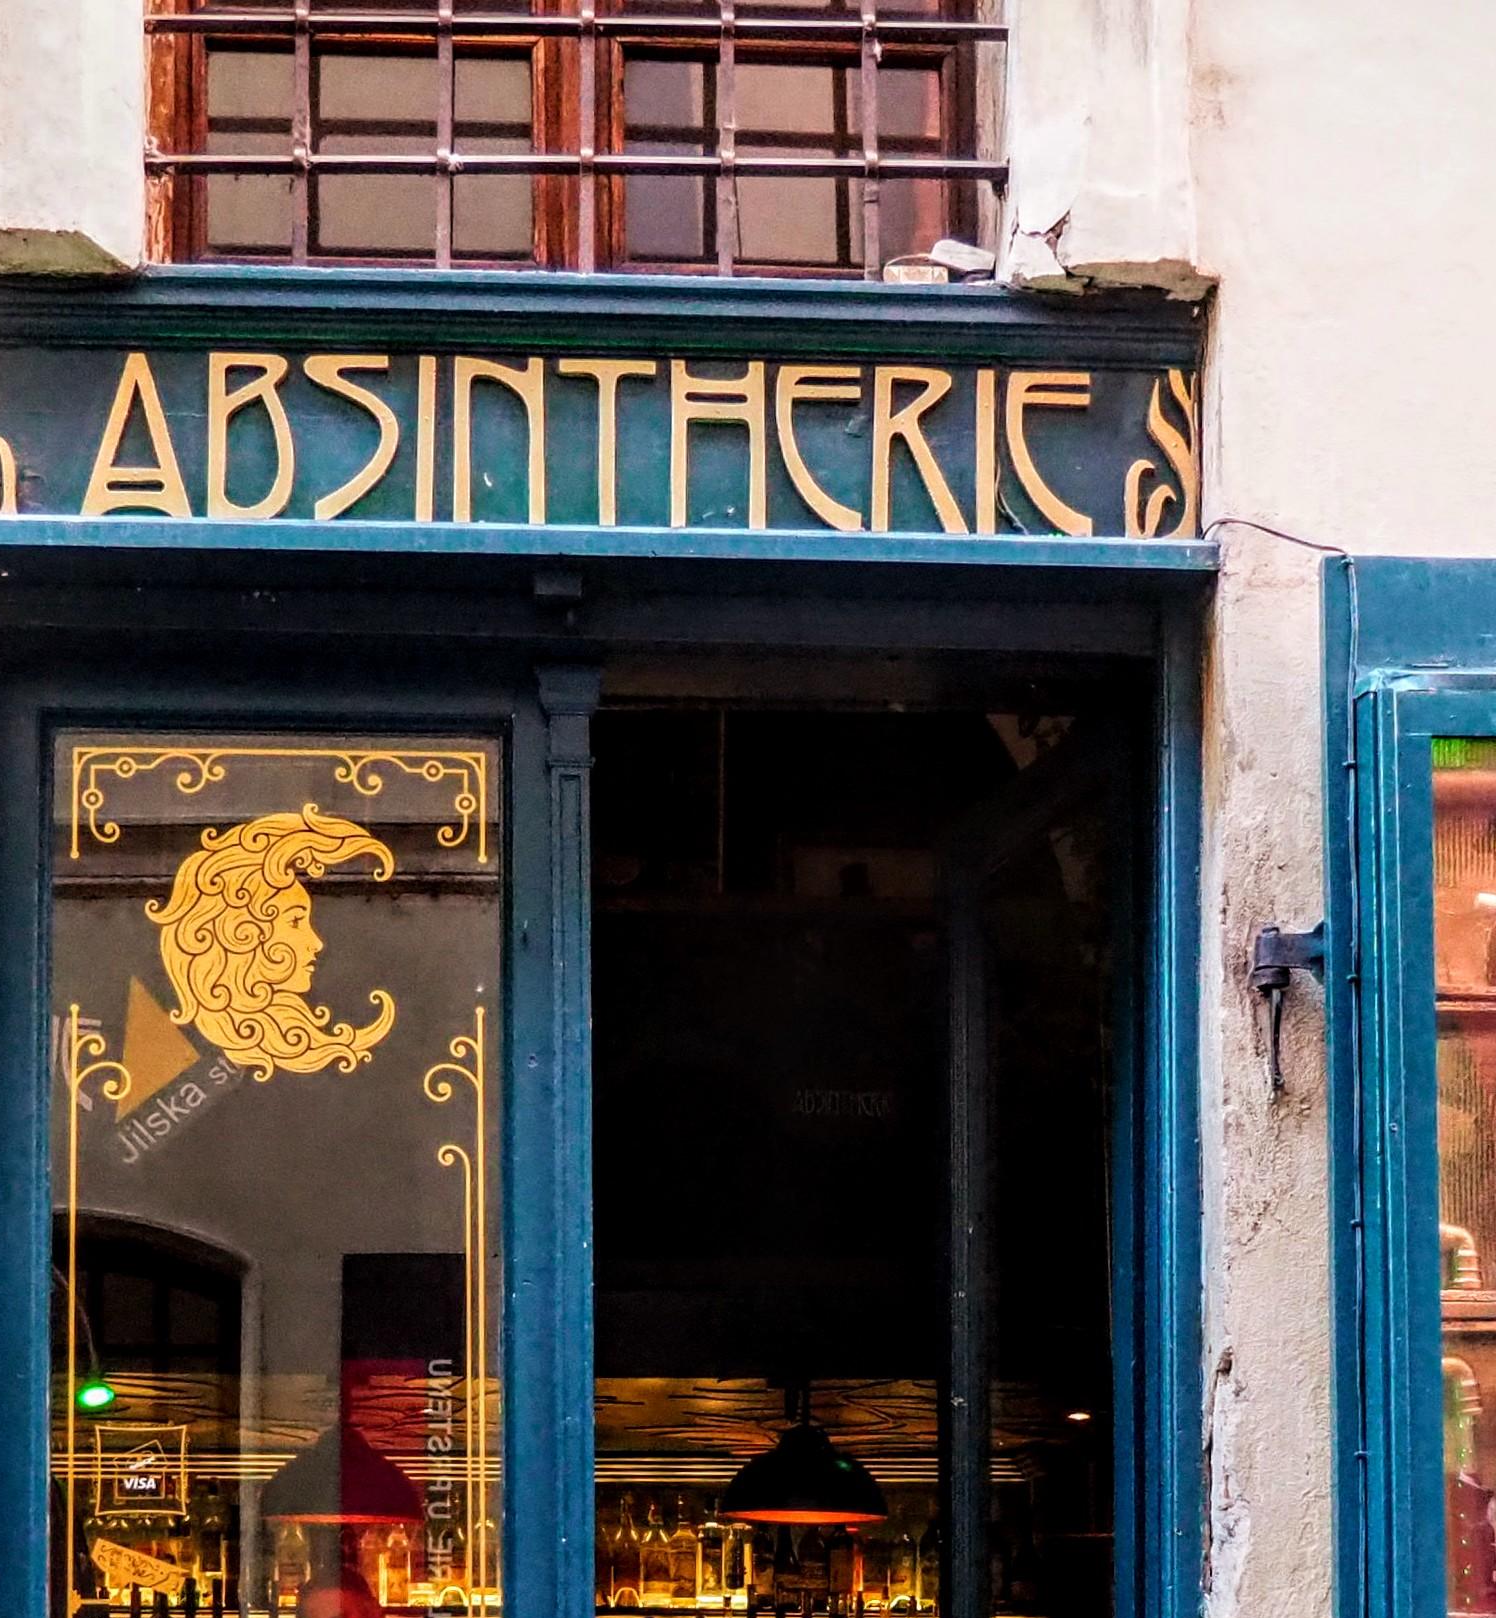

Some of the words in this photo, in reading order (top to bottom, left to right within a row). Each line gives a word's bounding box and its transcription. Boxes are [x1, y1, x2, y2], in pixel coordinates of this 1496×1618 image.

[81, 350, 1093, 536] ABSINTHERIE
[117, 1081, 207, 1164] Jilska
[124, 1477, 157, 1490] VISA
